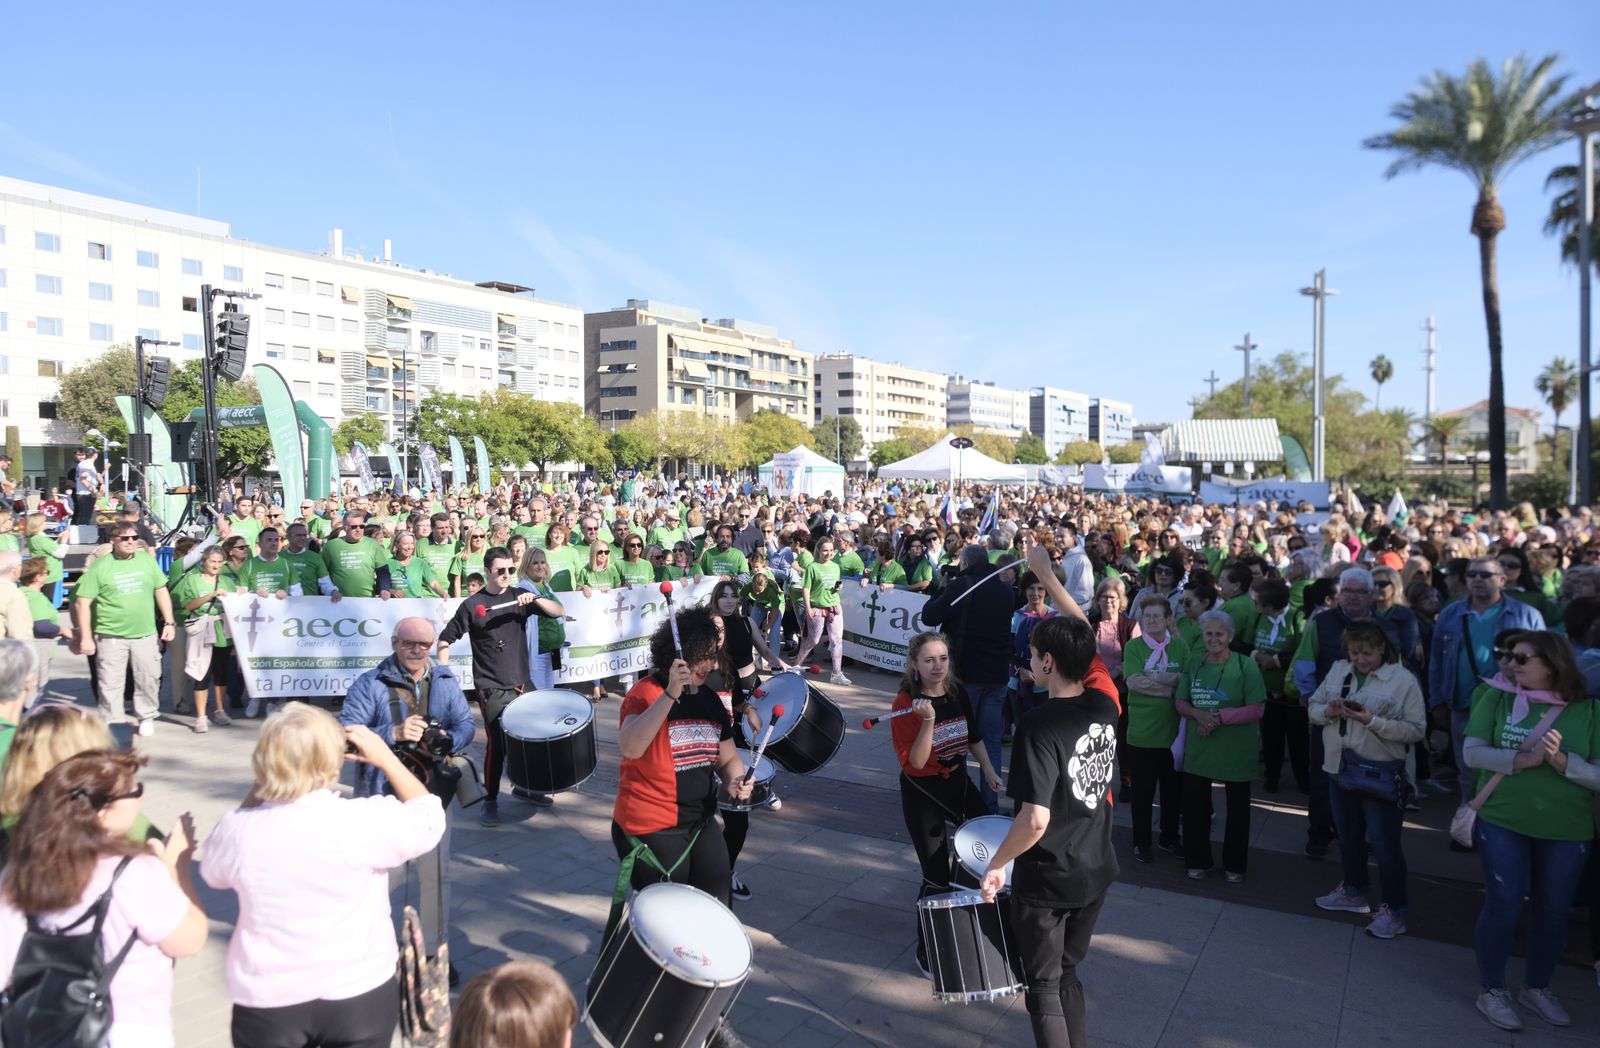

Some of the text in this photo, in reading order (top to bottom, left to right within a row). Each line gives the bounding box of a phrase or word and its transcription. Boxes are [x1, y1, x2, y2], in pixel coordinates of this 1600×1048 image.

[231, 408, 256, 417] aecc
[1248, 487, 1296, 501] aecc
[282, 617, 382, 638] aecc
[889, 607, 923, 635] ae
[339, 639, 369, 648] Cáncer
[860, 637, 909, 655] Asociación Espa
[273, 658, 315, 670] Española
[316, 657, 346, 667] Contra
[347, 658, 356, 667] el
[559, 652, 633, 678] Provincial
[863, 651, 881, 663] Junta
[882, 656, 902, 668] Local
[1501, 732, 1526, 743] cont
